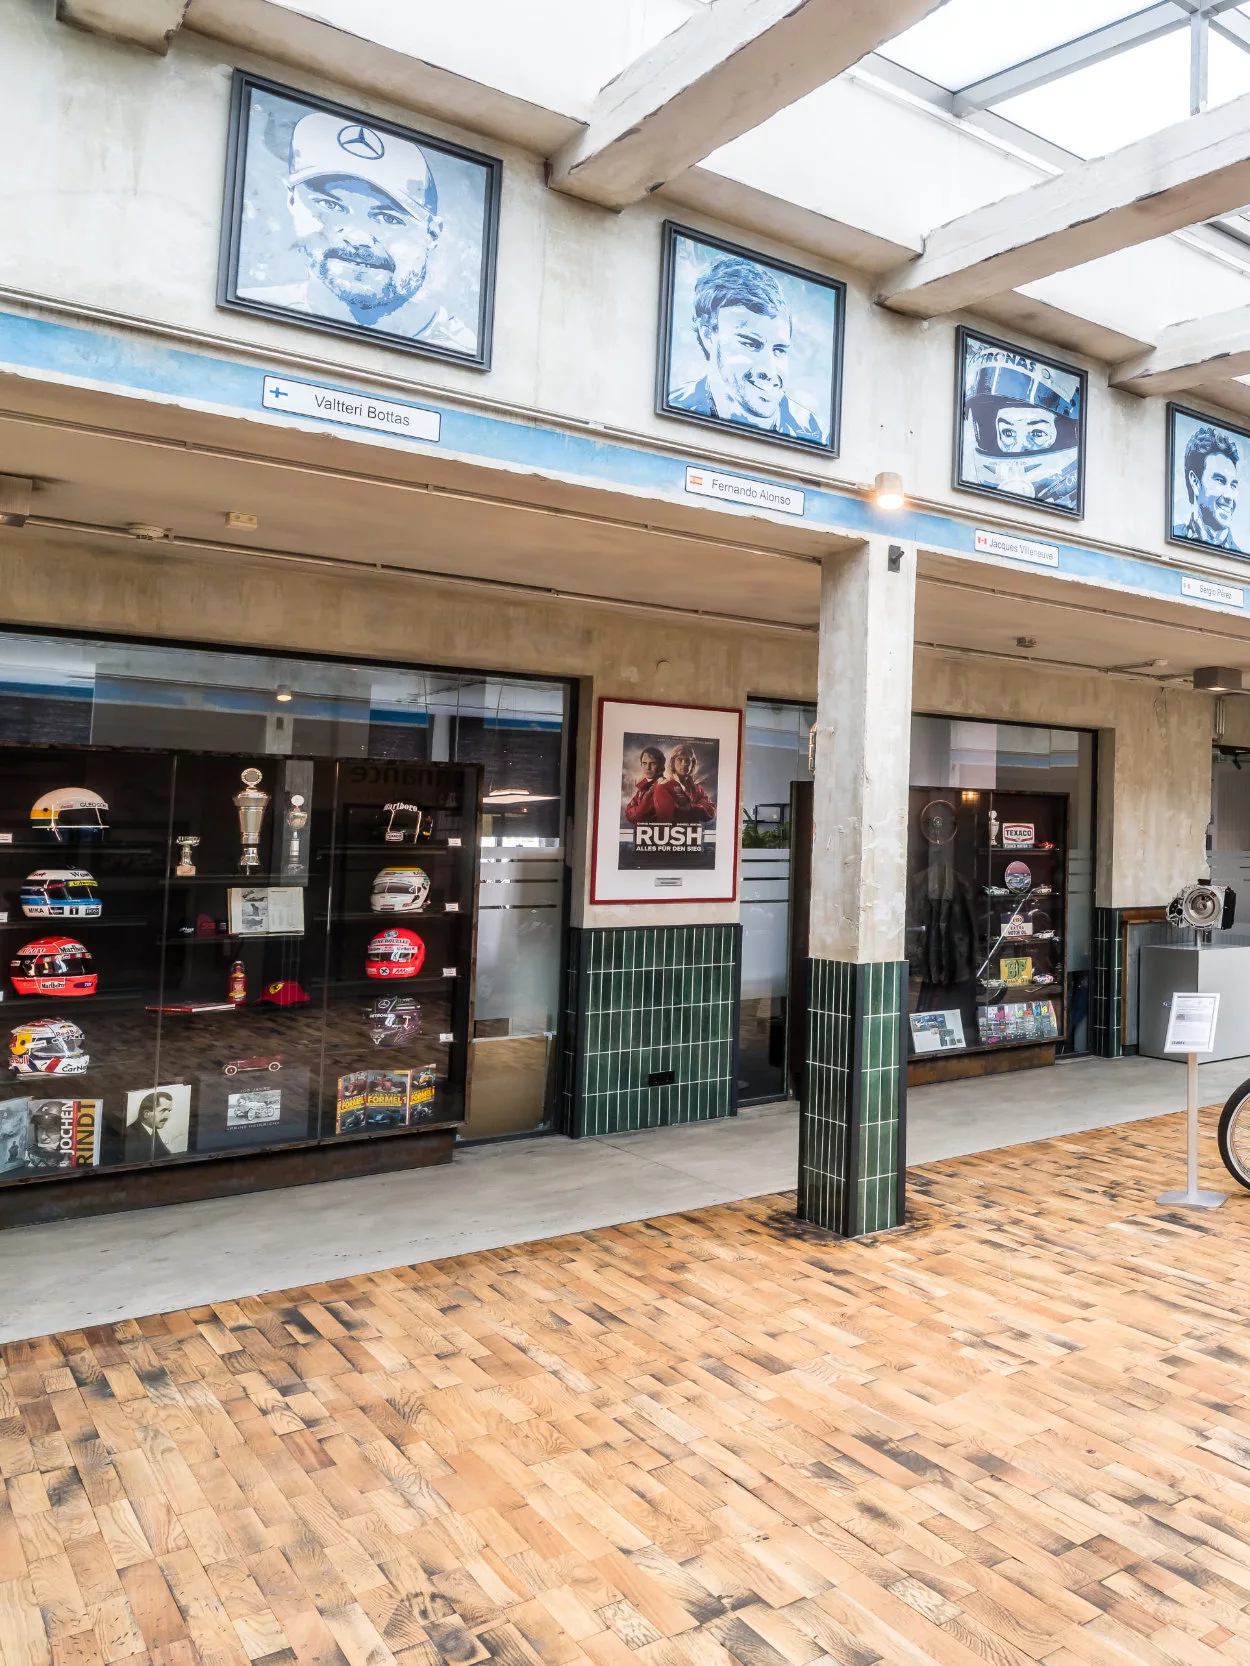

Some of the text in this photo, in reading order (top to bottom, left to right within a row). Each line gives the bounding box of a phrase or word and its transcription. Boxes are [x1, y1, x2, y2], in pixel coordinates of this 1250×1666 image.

[315, 394, 410, 426] Valtteri Bottas
[711, 478, 791, 506] Fernando Alonso
[989, 538, 1054, 561] Jacques Villeneuve
[636, 826, 702, 845] RUSH
[1005, 829, 1032, 837] TEXACO
[657, 844, 671, 852] FÜR
[367, 1096, 402, 1104] FORMEL
[60, 1100, 75, 1155] JOCHEN
[76, 1100, 96, 1165] RINDT
